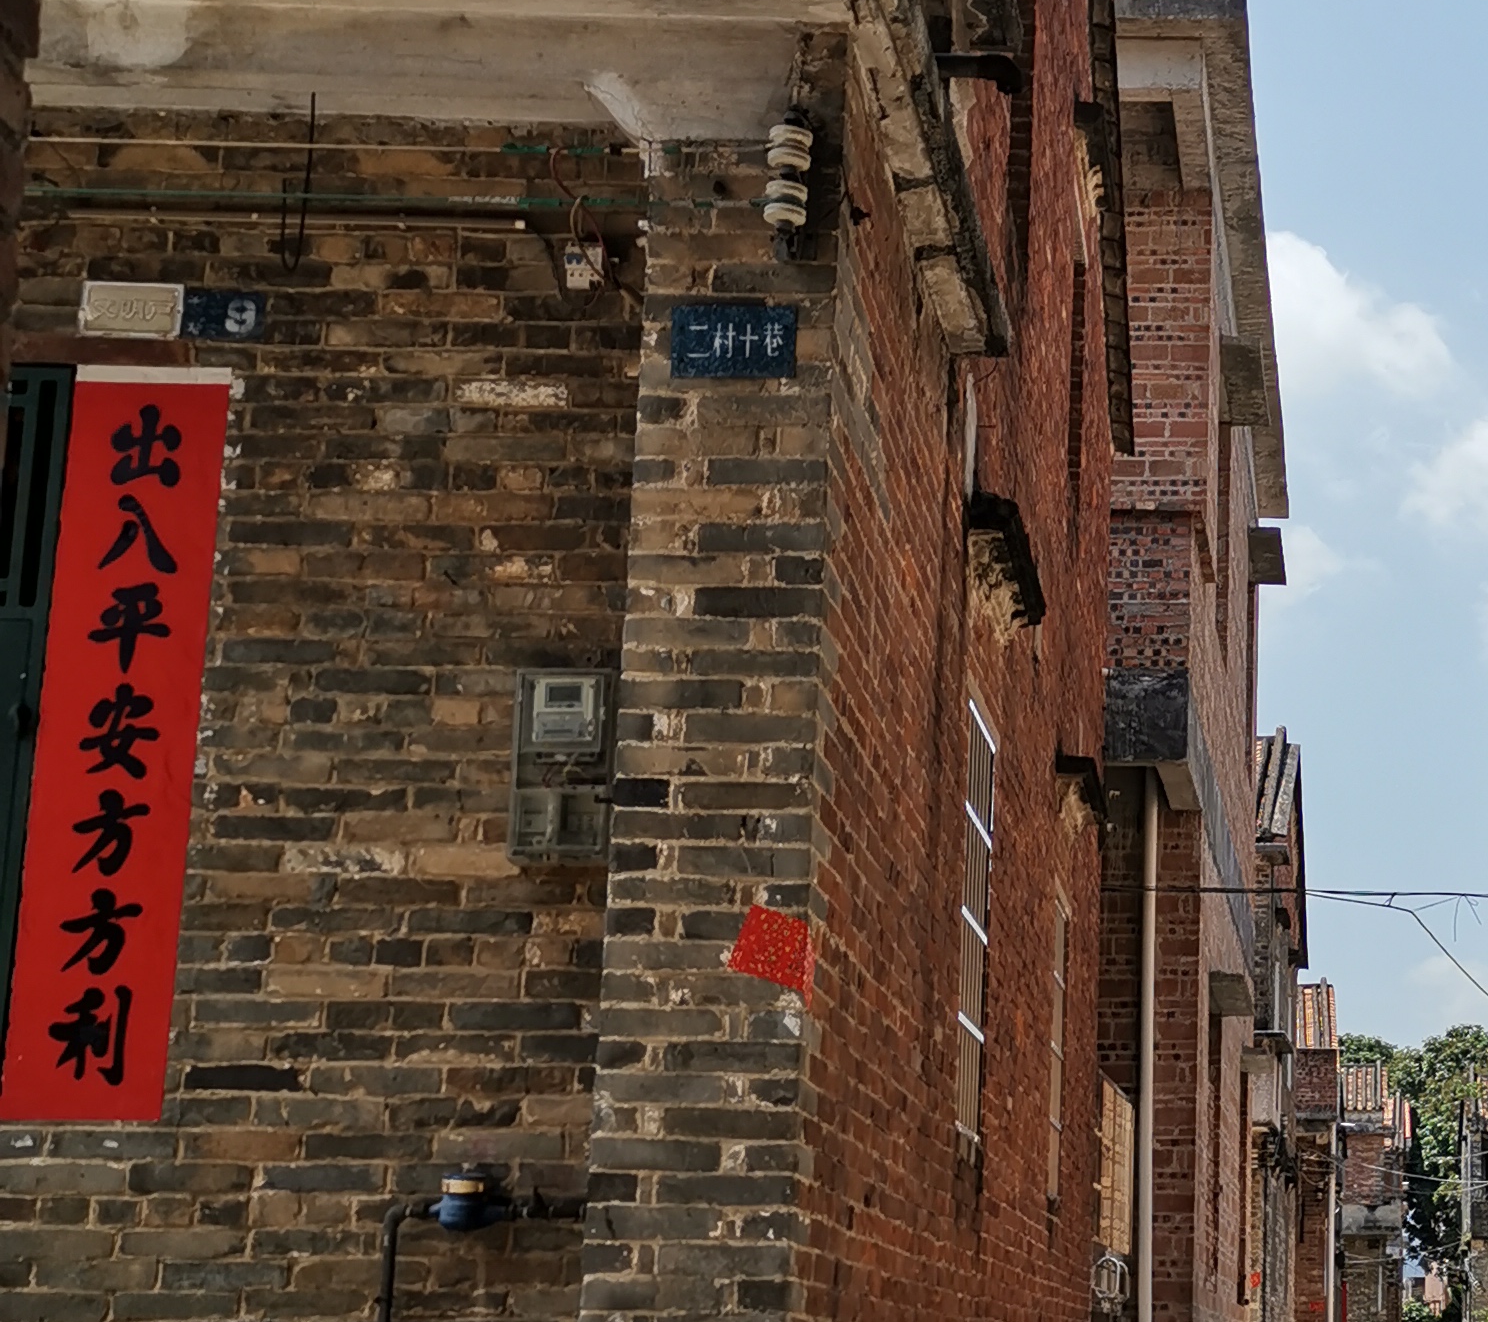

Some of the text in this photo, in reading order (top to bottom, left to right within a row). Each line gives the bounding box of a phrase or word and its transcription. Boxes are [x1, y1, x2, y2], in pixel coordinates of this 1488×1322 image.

[225, 299, 256, 333] 9
[686, 321, 784, 359] 二村十巷
[49, 404, 181, 1086] 出入平安方方利
